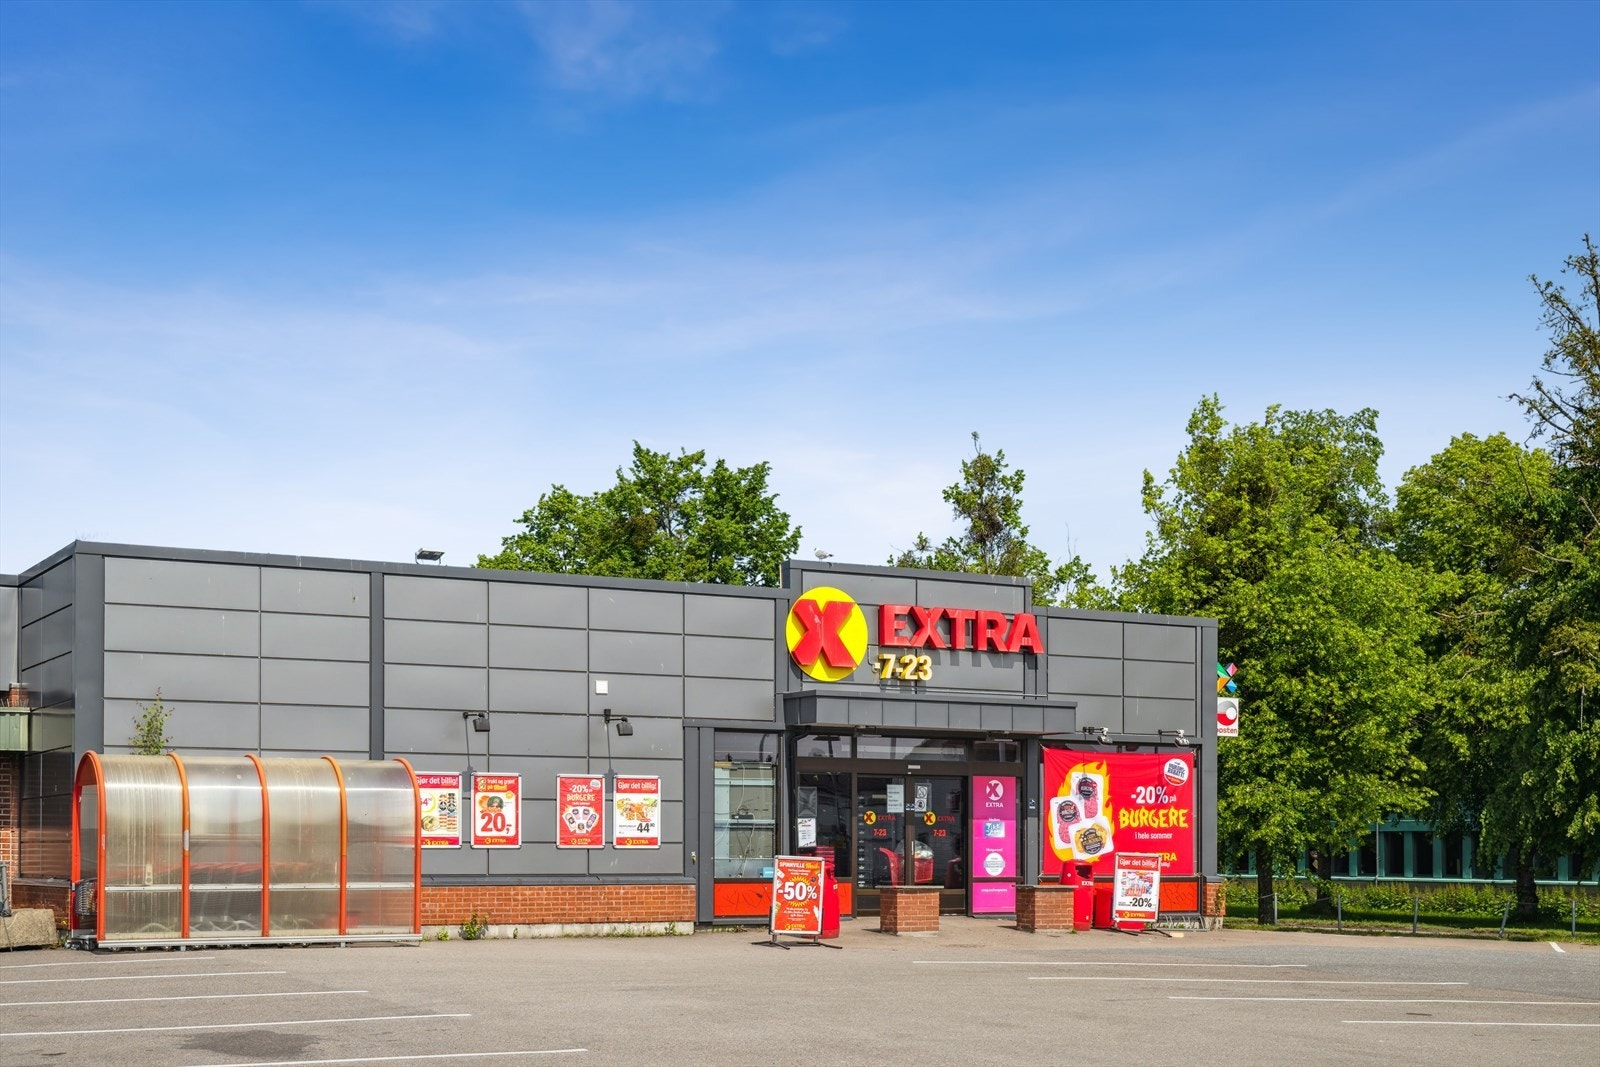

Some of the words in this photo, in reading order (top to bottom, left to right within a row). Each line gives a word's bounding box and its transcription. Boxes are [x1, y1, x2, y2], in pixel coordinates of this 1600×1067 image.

[878, 604, 1044, 654] EXTRA
[879, 653, 933, 681] 7-23
[441, 777, 458, 785] billig!
[617, 782, 630, 790] Gjør
[641, 782, 657, 790] billig!
[570, 784, 589, 793] -20%
[567, 793, 596, 802] BURGERE
[1131, 785, 1169, 804] -20%
[1169, 794, 1177, 803] på
[1118, 805, 1189, 829] BURGERE
[636, 822, 650, 833] 44
[873, 828, 887, 837] 7-23
[933, 829, 946, 837] 7-23
[1120, 858, 1131, 866] Gjør
[778, 881, 818, 901] -50%
[1129, 897, 1153, 908] -20%
